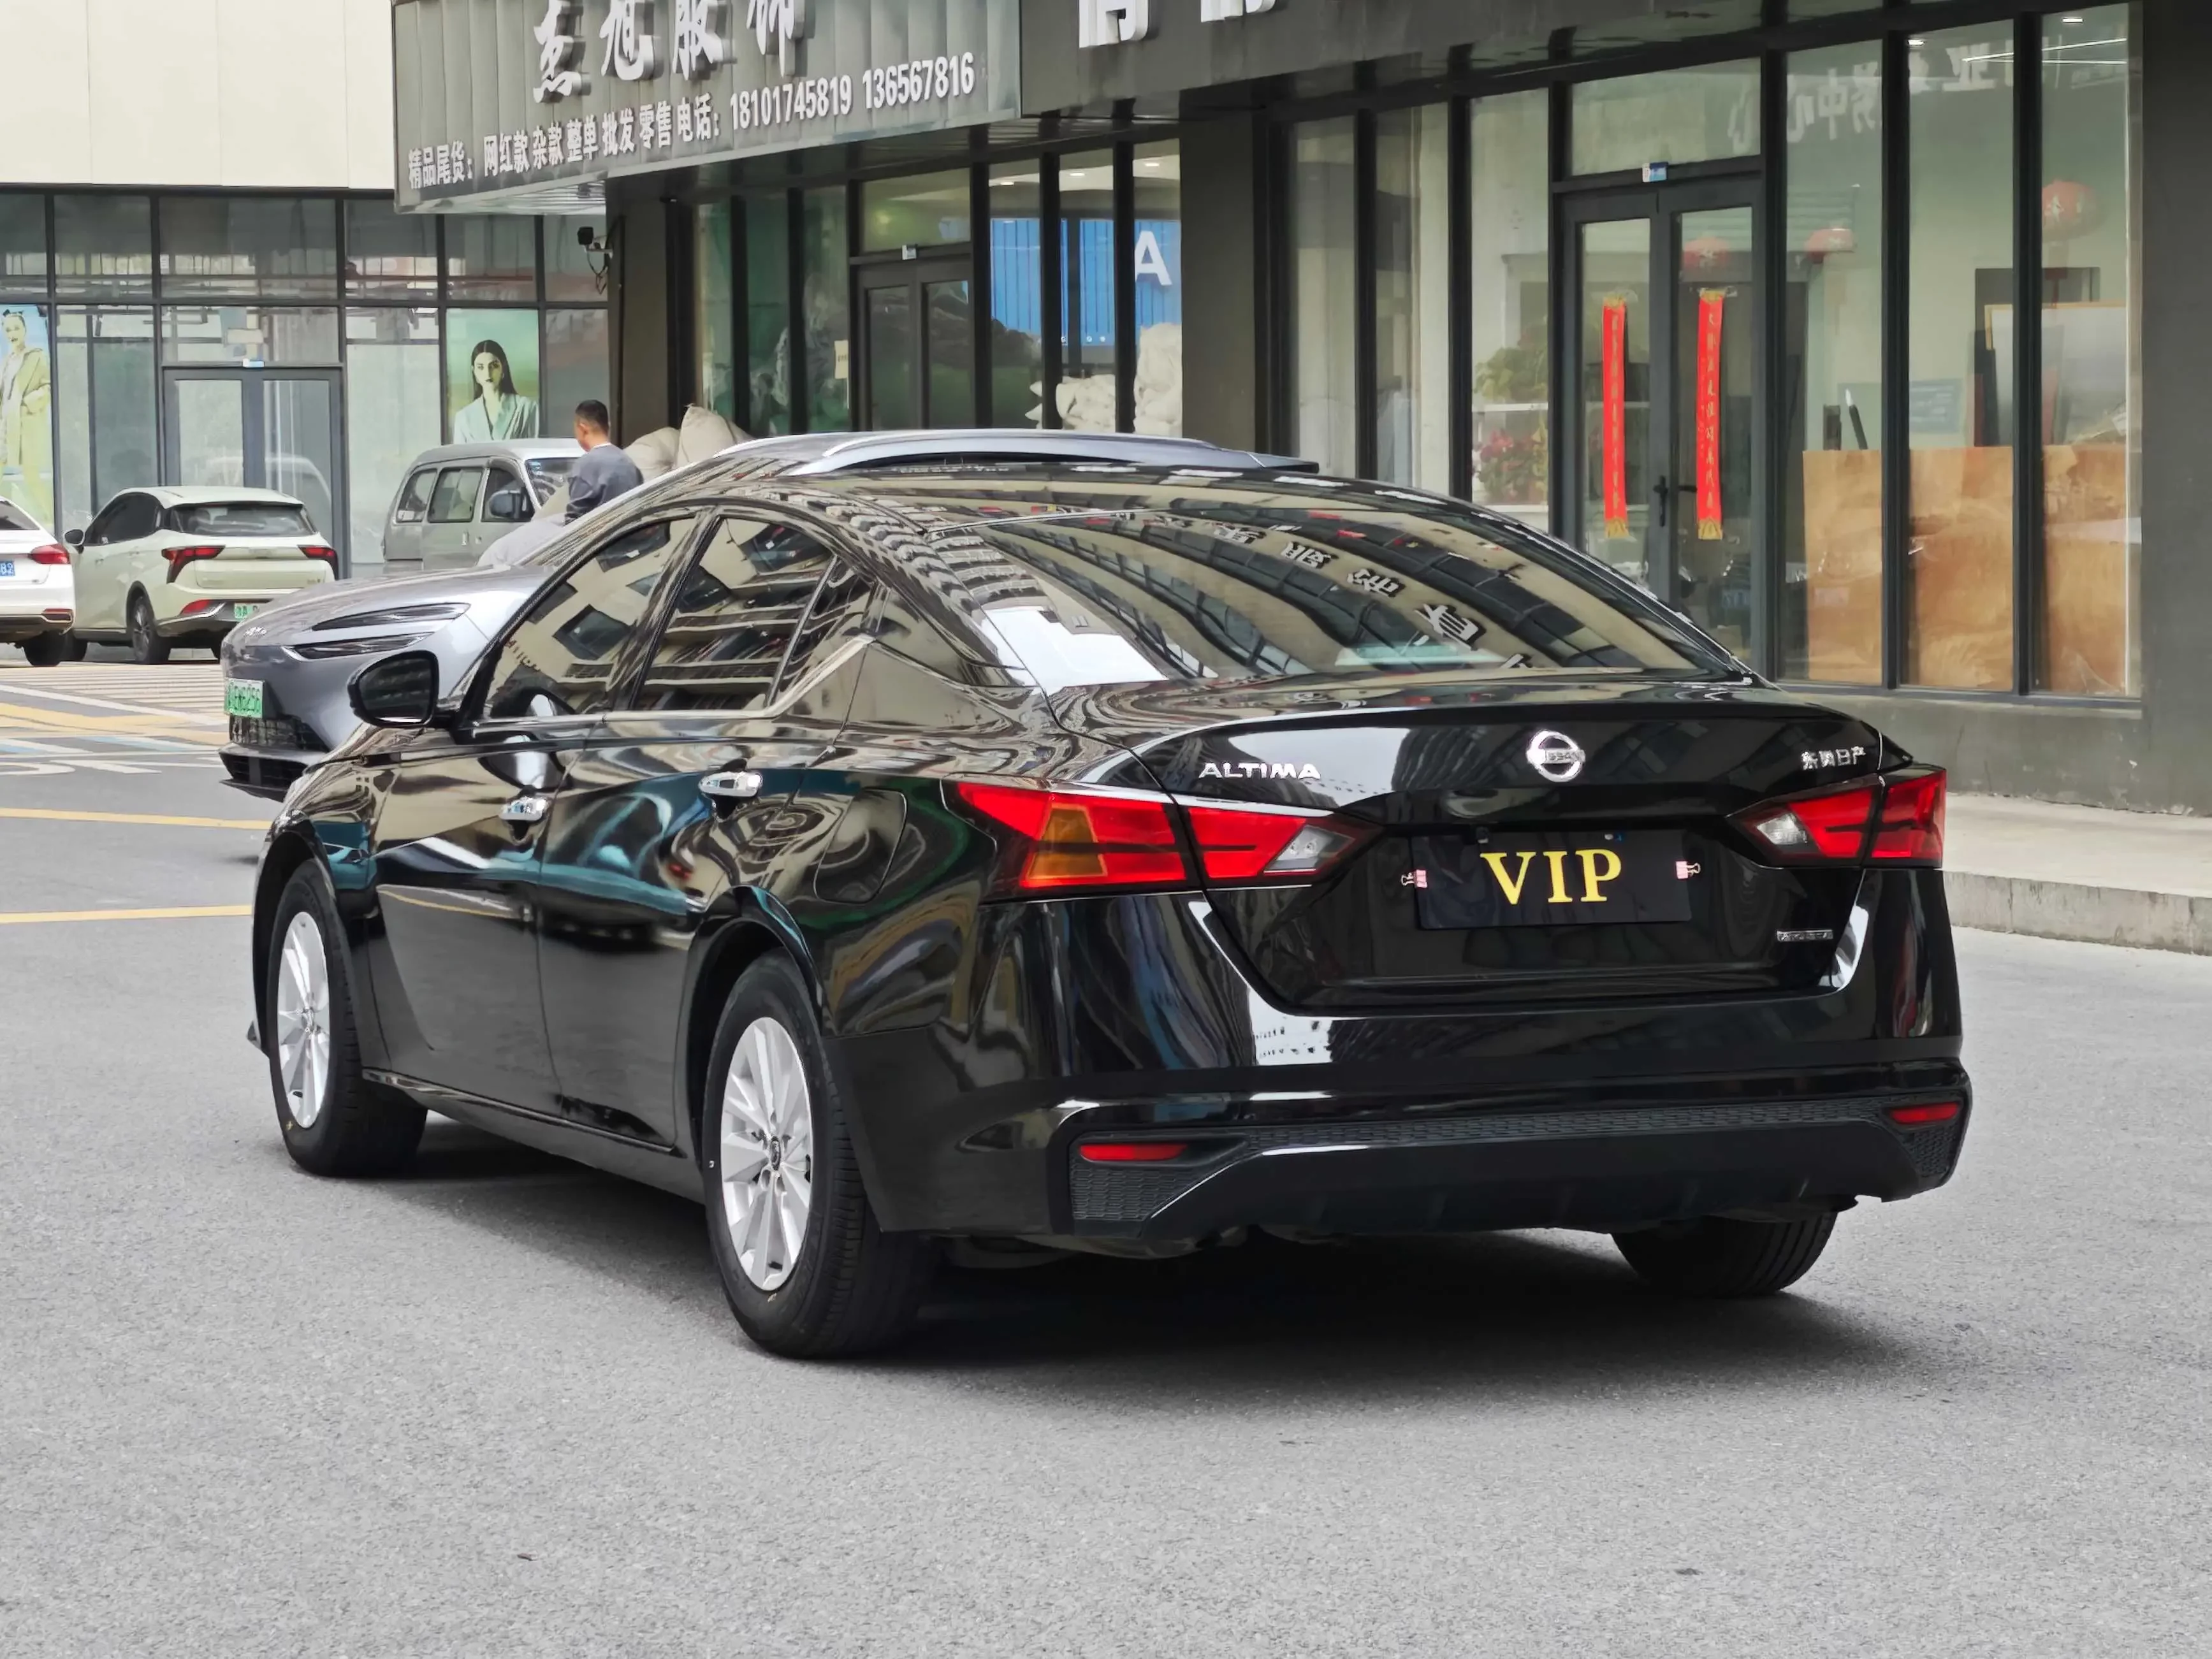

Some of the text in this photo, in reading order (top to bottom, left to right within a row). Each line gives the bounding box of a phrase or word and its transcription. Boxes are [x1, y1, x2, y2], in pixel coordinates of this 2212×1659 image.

[639, 101, 672, 149] 零售
[730, 75, 852, 130] 18101745819
[862, 52, 974, 110] 136567816
[1198, 762, 1321, 779] ALTIMA
[1480, 848, 1622, 905] VIP
